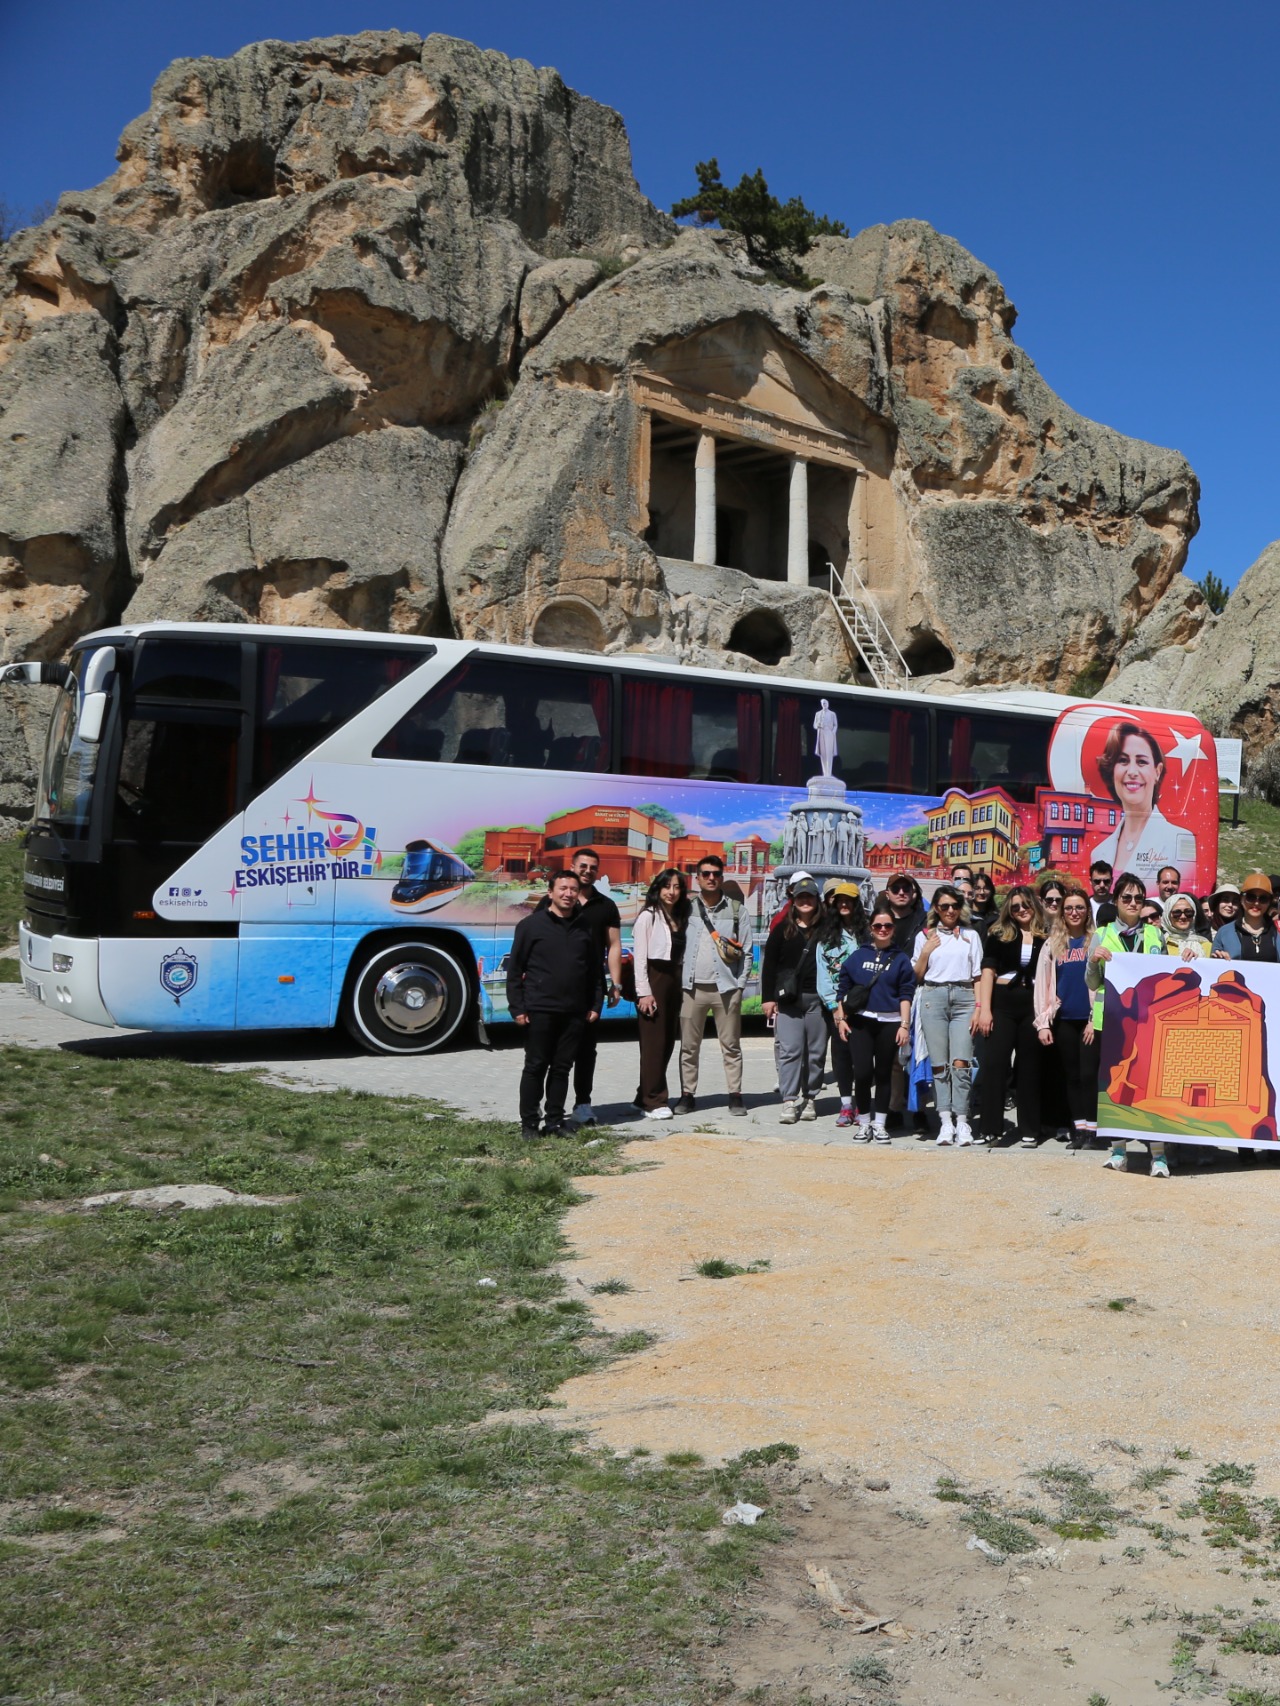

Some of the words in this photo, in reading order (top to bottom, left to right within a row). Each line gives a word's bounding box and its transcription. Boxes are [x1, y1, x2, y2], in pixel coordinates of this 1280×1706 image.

[241, 826, 326, 866] ŞEHİR
[235, 861, 360, 888] ESKİŞEHİR'DİR
[159, 898, 208, 907] eskisehirbb
